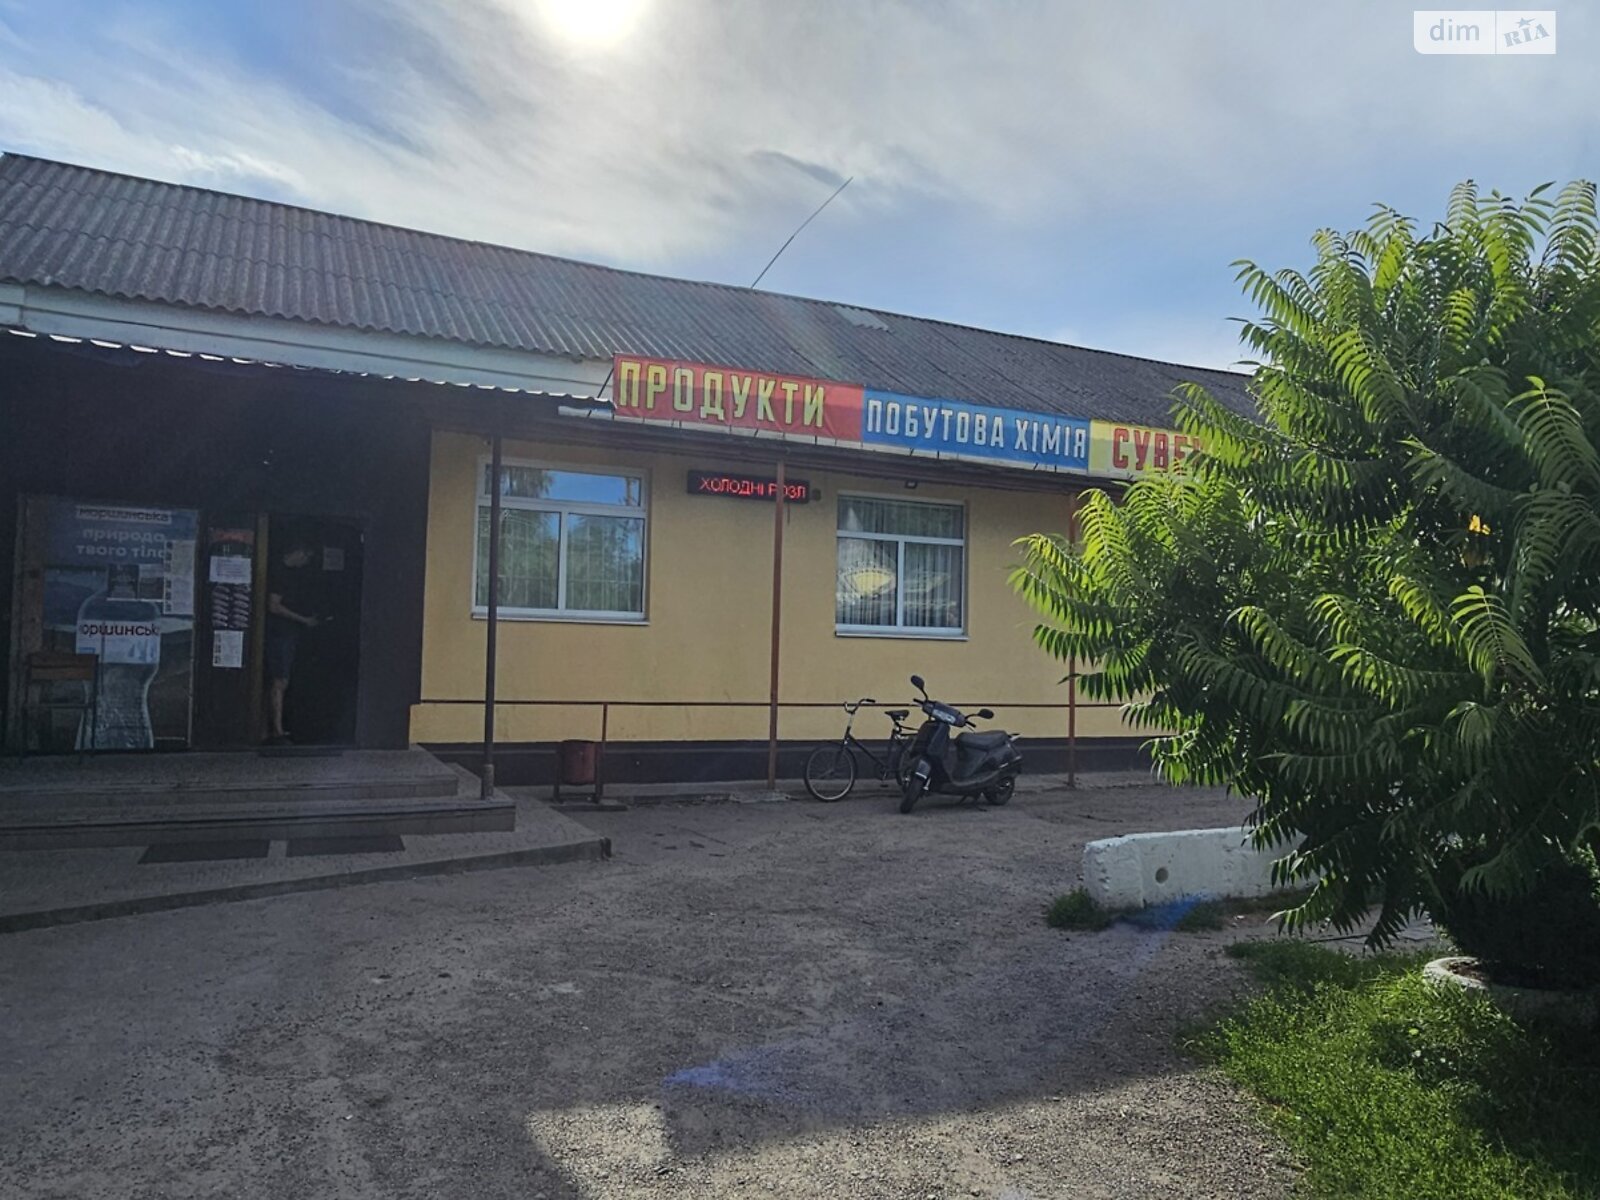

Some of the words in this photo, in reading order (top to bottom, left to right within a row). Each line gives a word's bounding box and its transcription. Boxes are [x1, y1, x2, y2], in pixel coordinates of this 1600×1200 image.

[620, 360, 825, 428] ПРОДУКТИ
[867, 400, 1004, 448] ПОБУТОВА
[1014, 419, 1087, 459] ХІМІЯ
[1113, 427, 1202, 476] СУВЕ
[699, 477, 764, 497] ХОЛОДНІ
[76, 545, 127, 557] твого
[83, 528, 165, 544] природа
